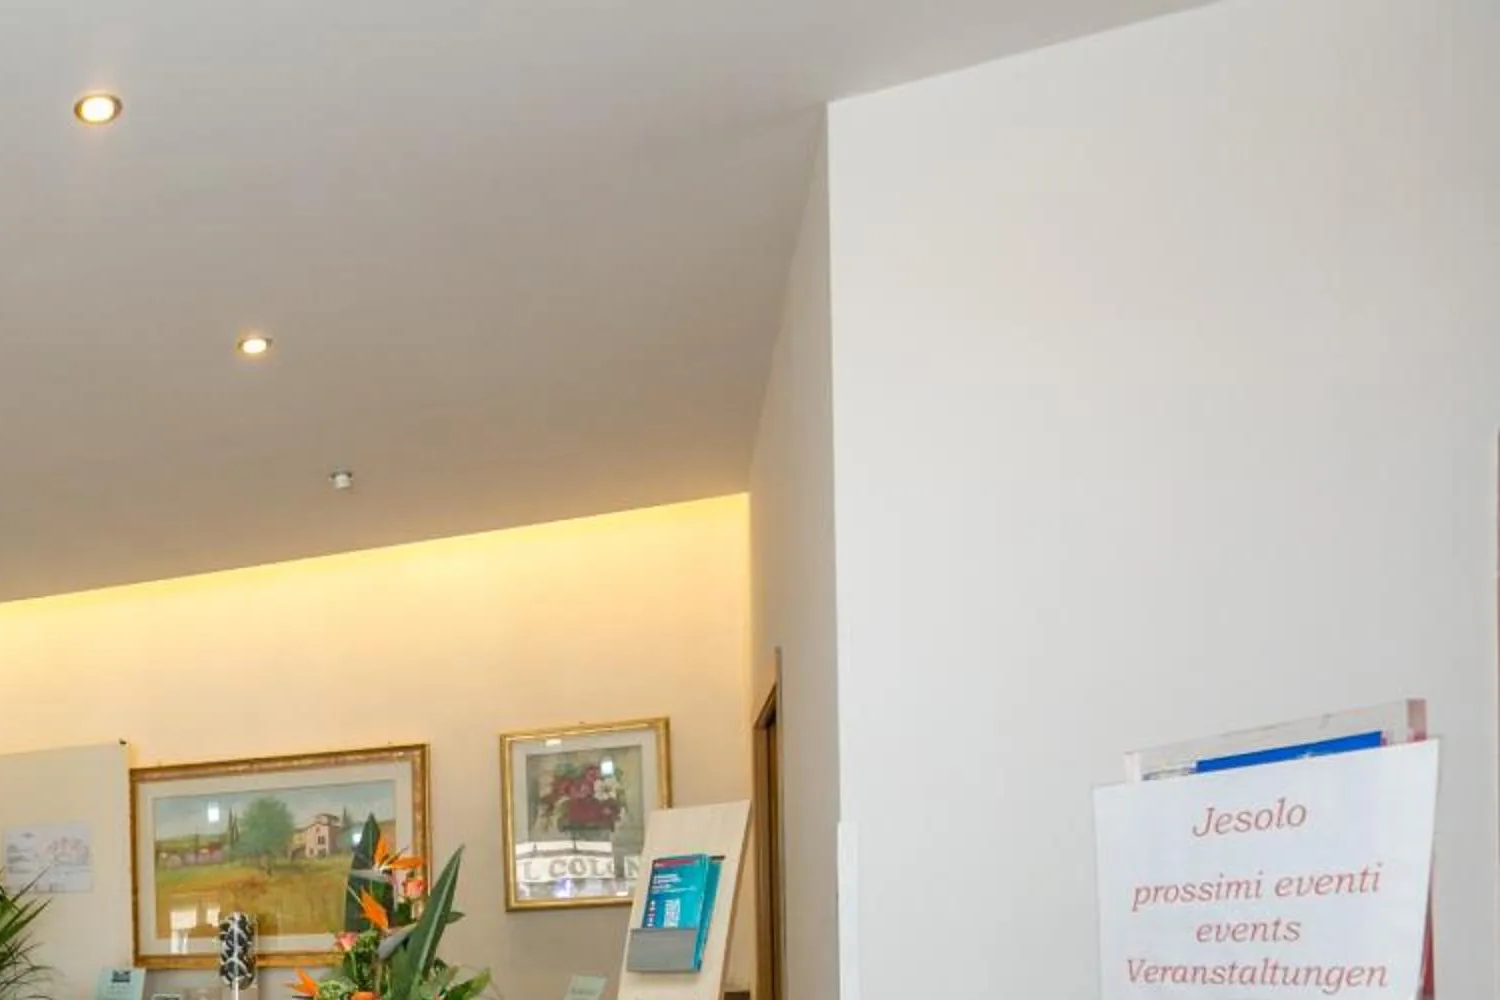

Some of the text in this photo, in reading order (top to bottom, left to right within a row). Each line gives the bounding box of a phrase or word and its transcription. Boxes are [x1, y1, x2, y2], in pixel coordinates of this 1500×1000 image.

[1191, 797, 1308, 839] Jesolo
[1131, 863, 1381, 911] prossimi eventi
[1195, 917, 1302, 944] events
[1126, 957, 1388, 995] Veranstaltungen
